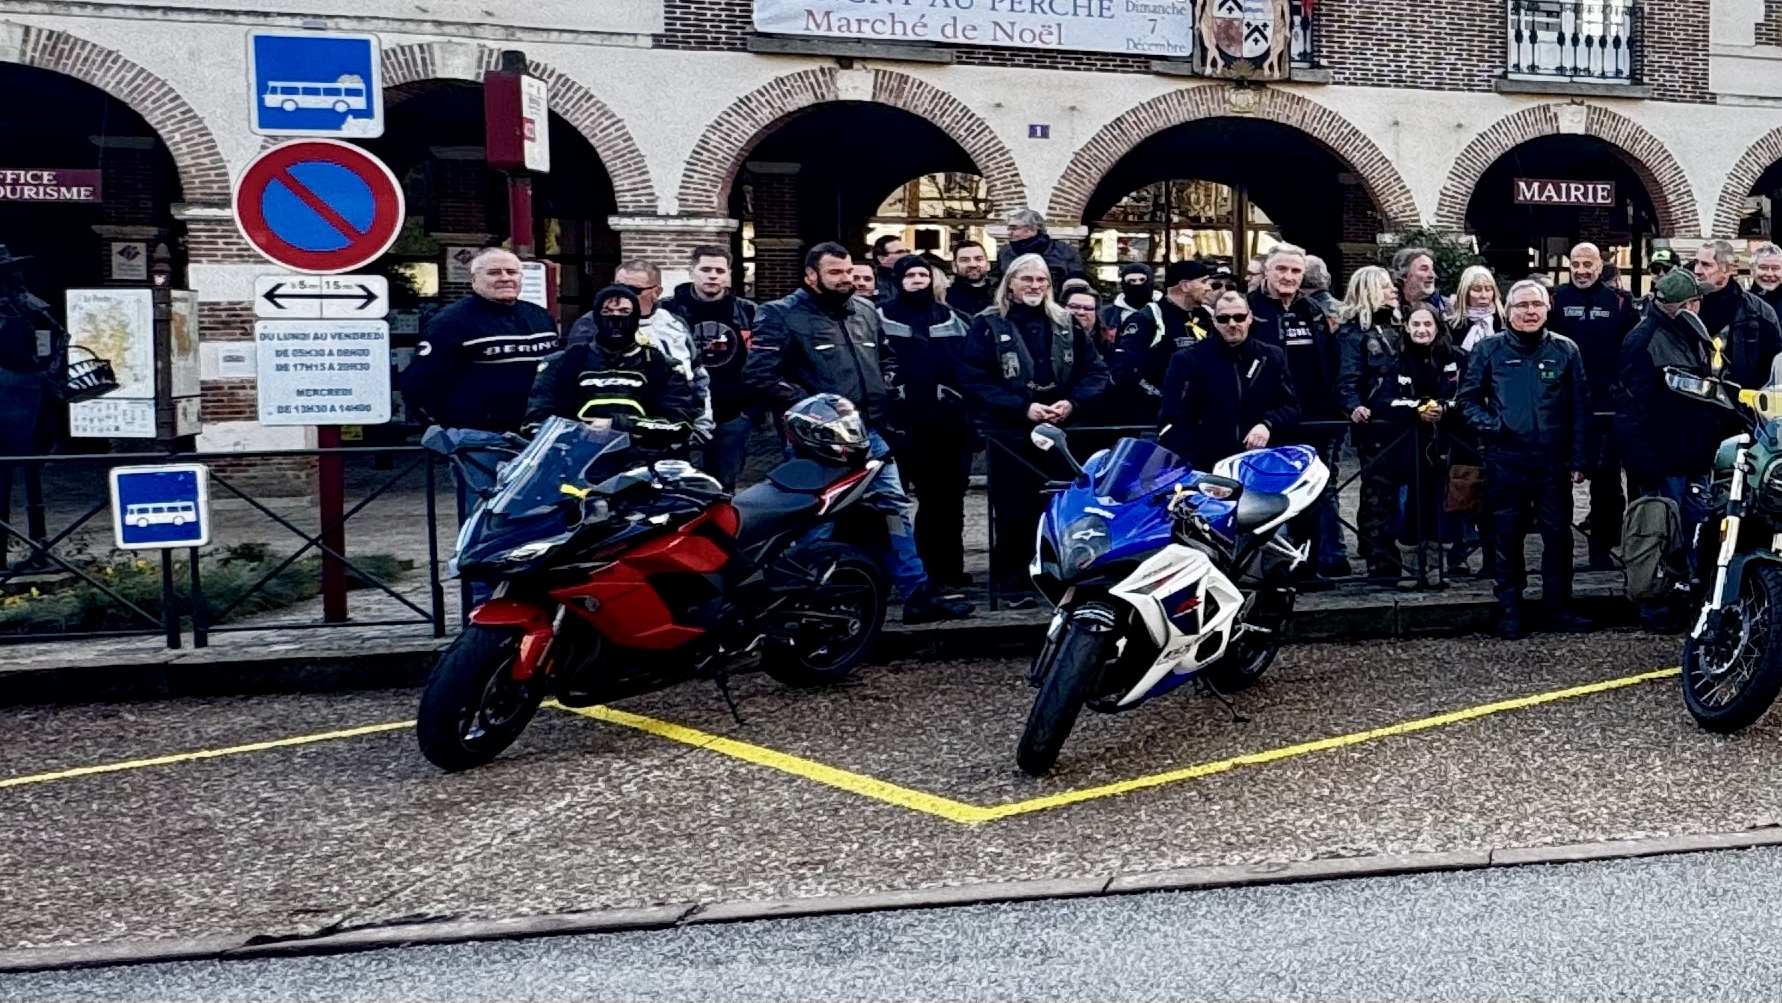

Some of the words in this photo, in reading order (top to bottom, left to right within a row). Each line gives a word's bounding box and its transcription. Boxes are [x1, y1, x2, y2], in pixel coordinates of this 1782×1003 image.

[1125, 0, 1186, 16] Dimanche
[804, 9, 929, 37] Marché
[940, 16, 978, 40] de
[991, 20, 1064, 46] Noël
[1147, 19, 1158, 35] 7
[1126, 38, 1186, 54] Décembre
[1518, 181, 1611, 203] MAIRIE
[259, 332, 275, 341] DU
[277, 332, 310, 341] LUNDI
[312, 332, 327, 341] AU
[330, 332, 384, 341] VENDREDI
[275, 349, 289, 357] DE
[327, 349, 335, 357] A
[275, 363, 290, 371] DE
[328, 363, 336, 371] A
[296, 388, 353, 397] MERCREDI
[277, 405, 291, 414] DE
[329, 405, 337, 413] A
